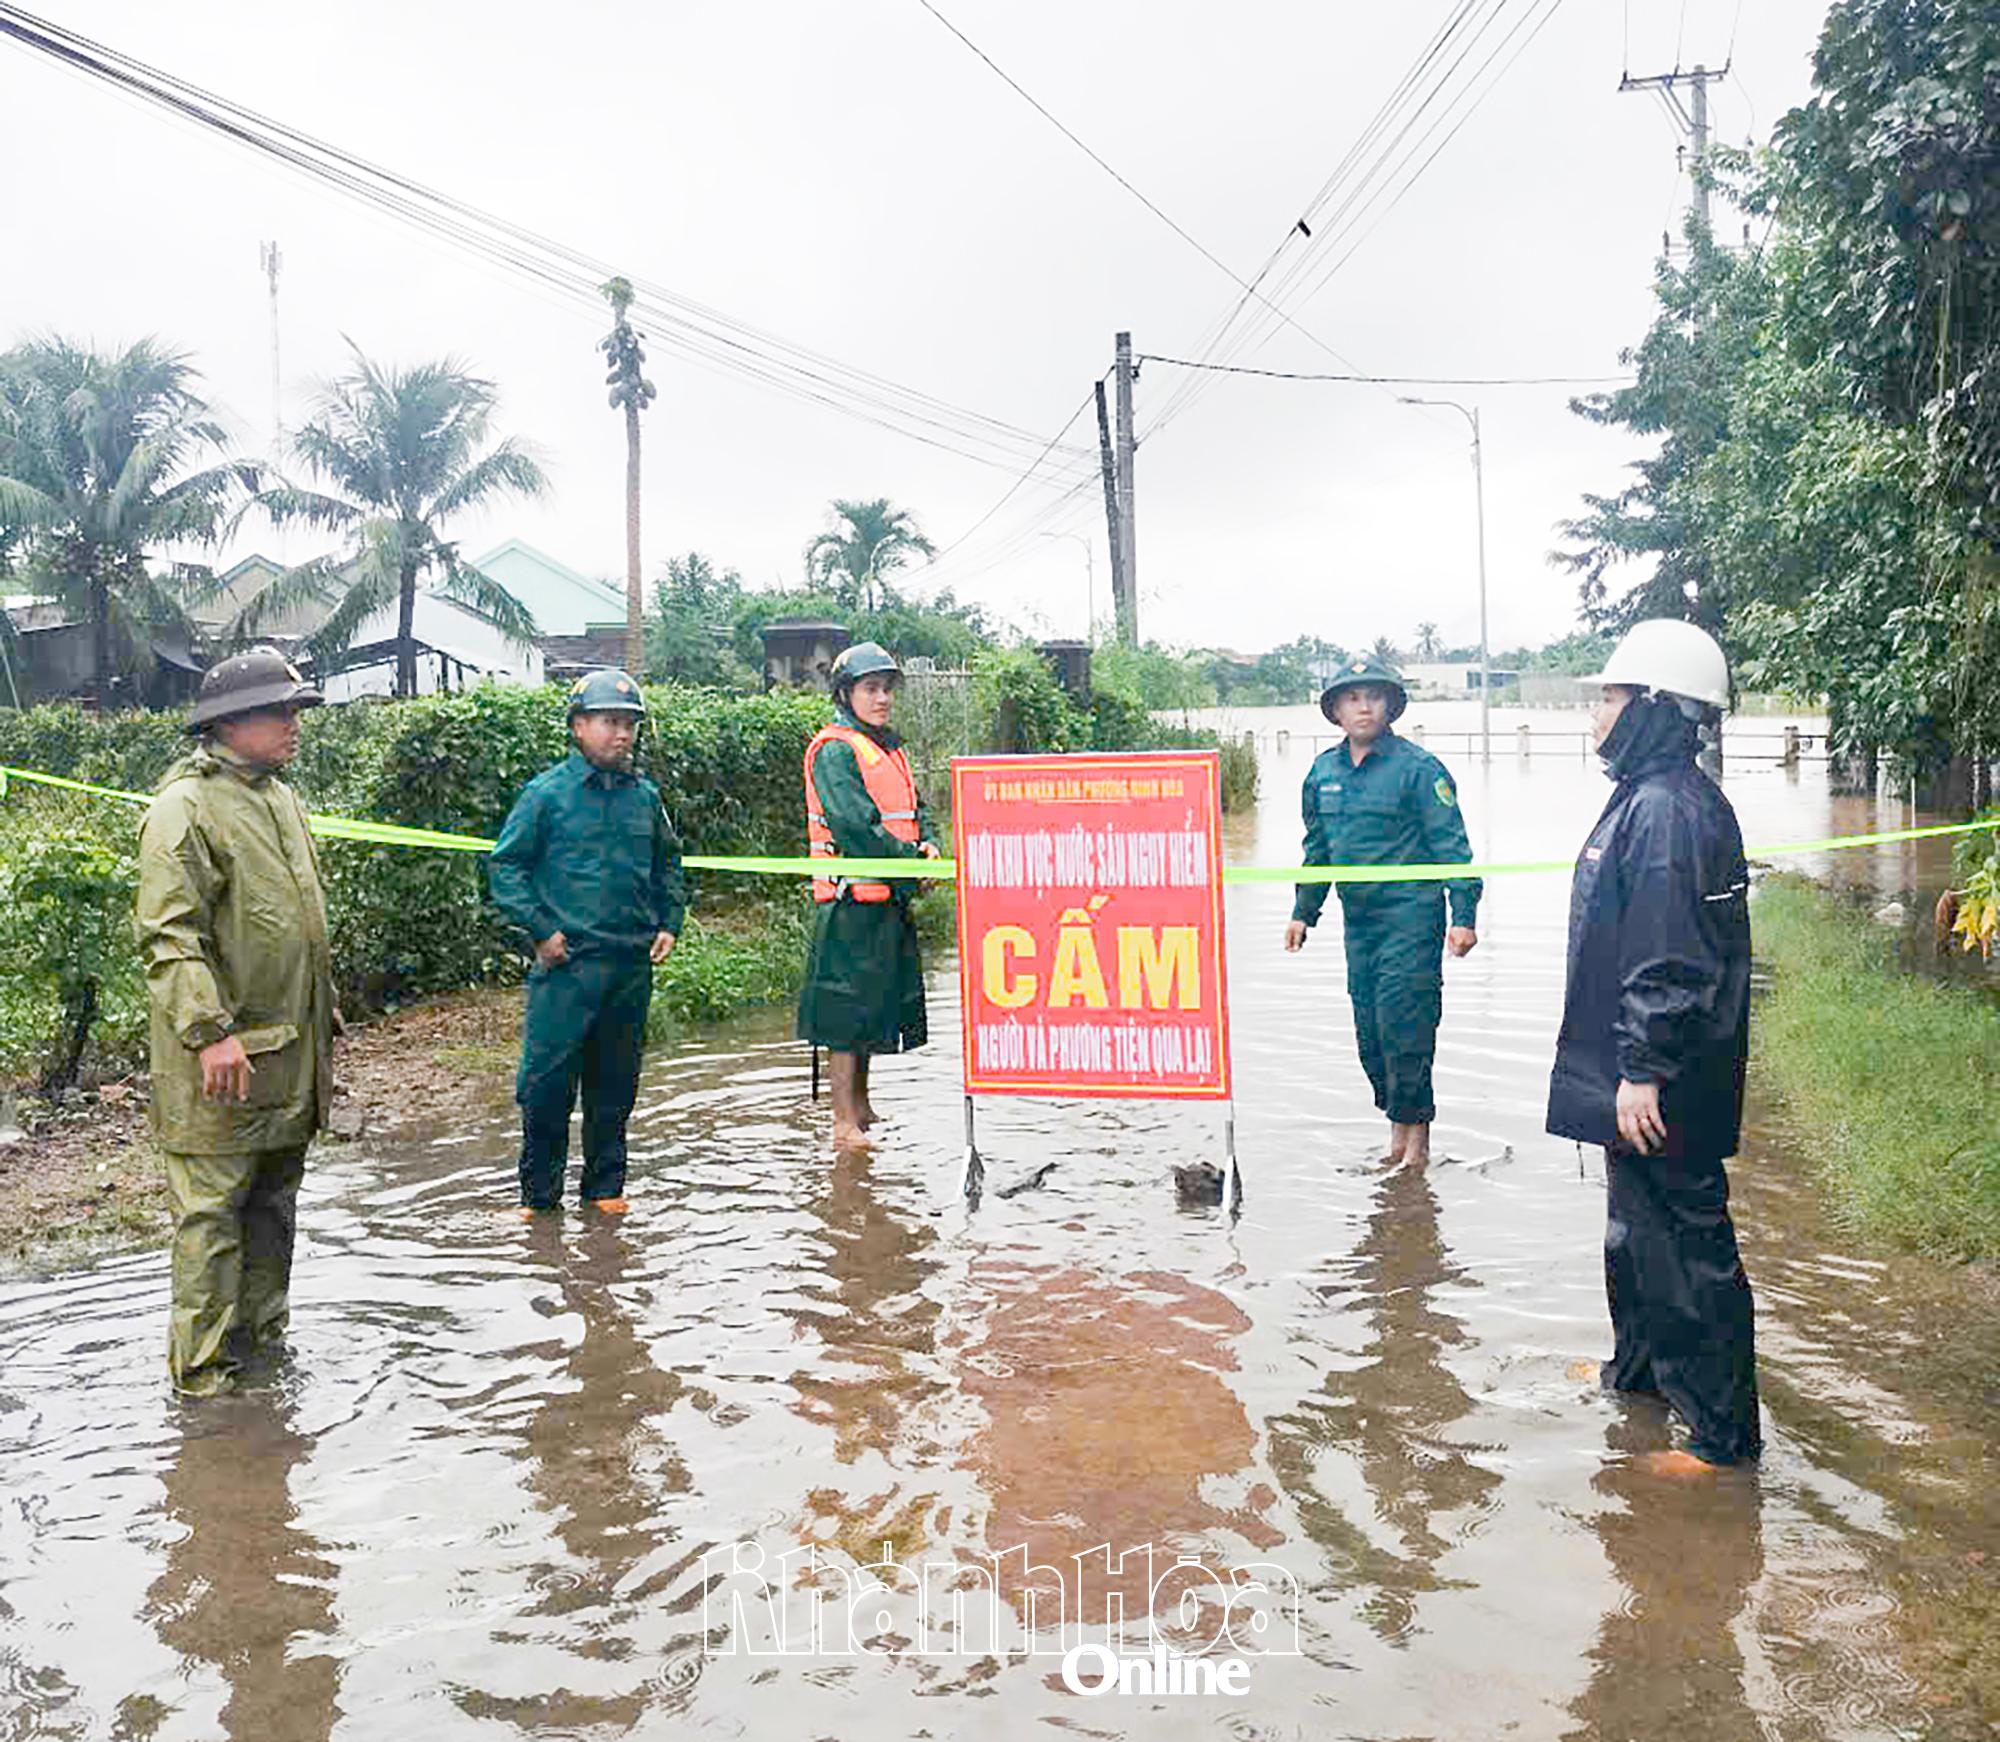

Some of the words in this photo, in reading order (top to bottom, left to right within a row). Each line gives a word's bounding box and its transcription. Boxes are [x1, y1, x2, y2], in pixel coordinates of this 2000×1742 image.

[995, 834, 1022, 887] KHU
[1024, 829, 1052, 899] VỰC
[1055, 822, 1093, 887] NƯỚC
[1097, 822, 1125, 887] SÂU
[1127, 832, 1166, 887] NGUY
[1169, 808, 1207, 886] HIỂM
[982, 895, 1201, 1010] CẤM
[978, 1014, 1024, 1070] NGƯỜI
[1026, 1015, 1047, 1071] VÀ
[1049, 1023, 1111, 1072] PHƯƠNG
[1113, 1016, 1149, 1082] TIỆN
[1152, 1027, 1183, 1078] QUA
[1185, 1027, 1212, 1084] LẠI
